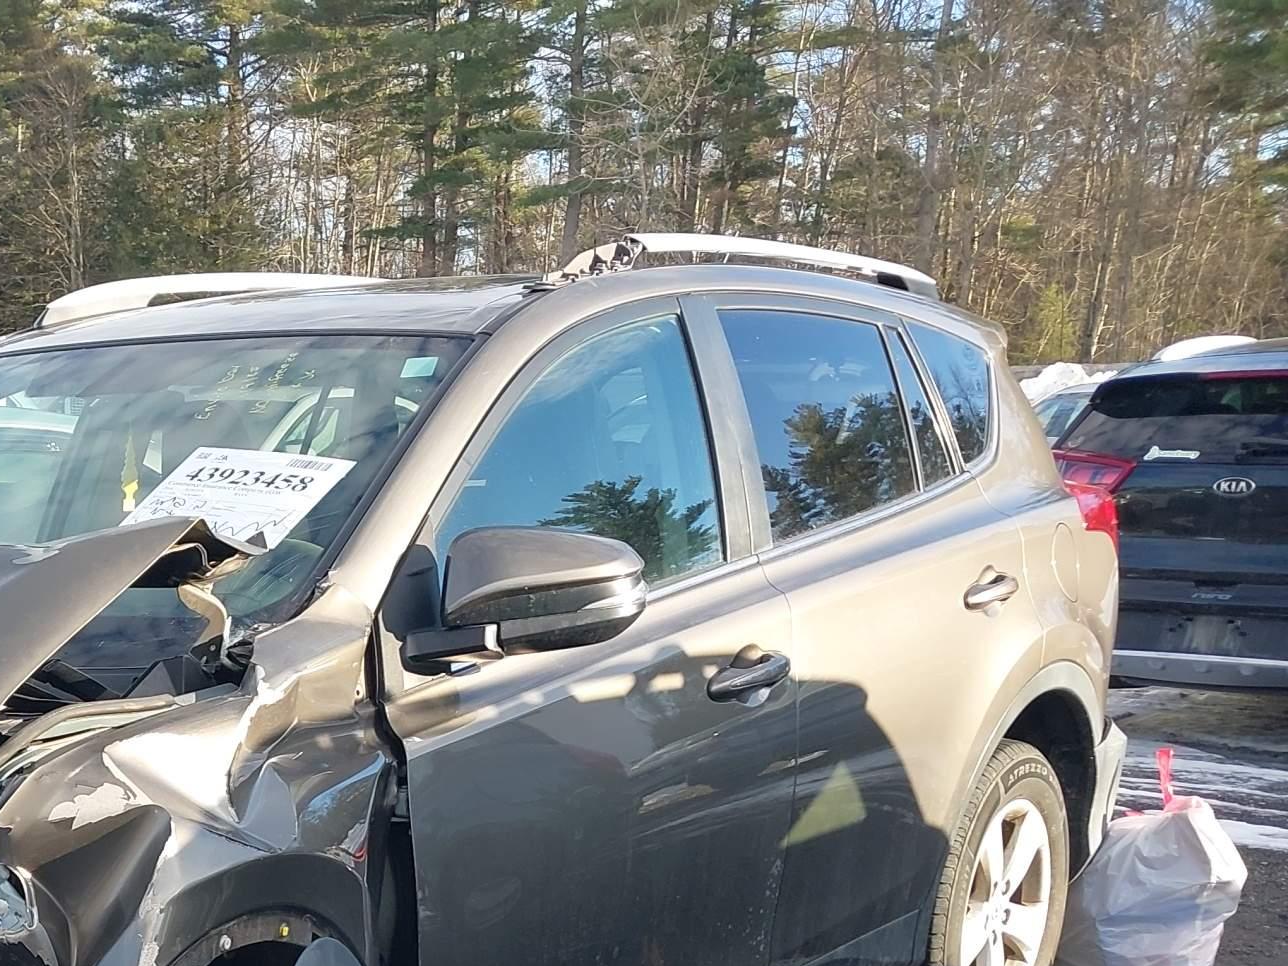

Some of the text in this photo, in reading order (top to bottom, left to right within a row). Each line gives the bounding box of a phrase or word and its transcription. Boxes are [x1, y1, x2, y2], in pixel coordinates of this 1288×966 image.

[186, 465, 315, 492] 43923458
[1219, 481, 1248, 493] KIA
[1007, 763, 1048, 787] ATREZZO
